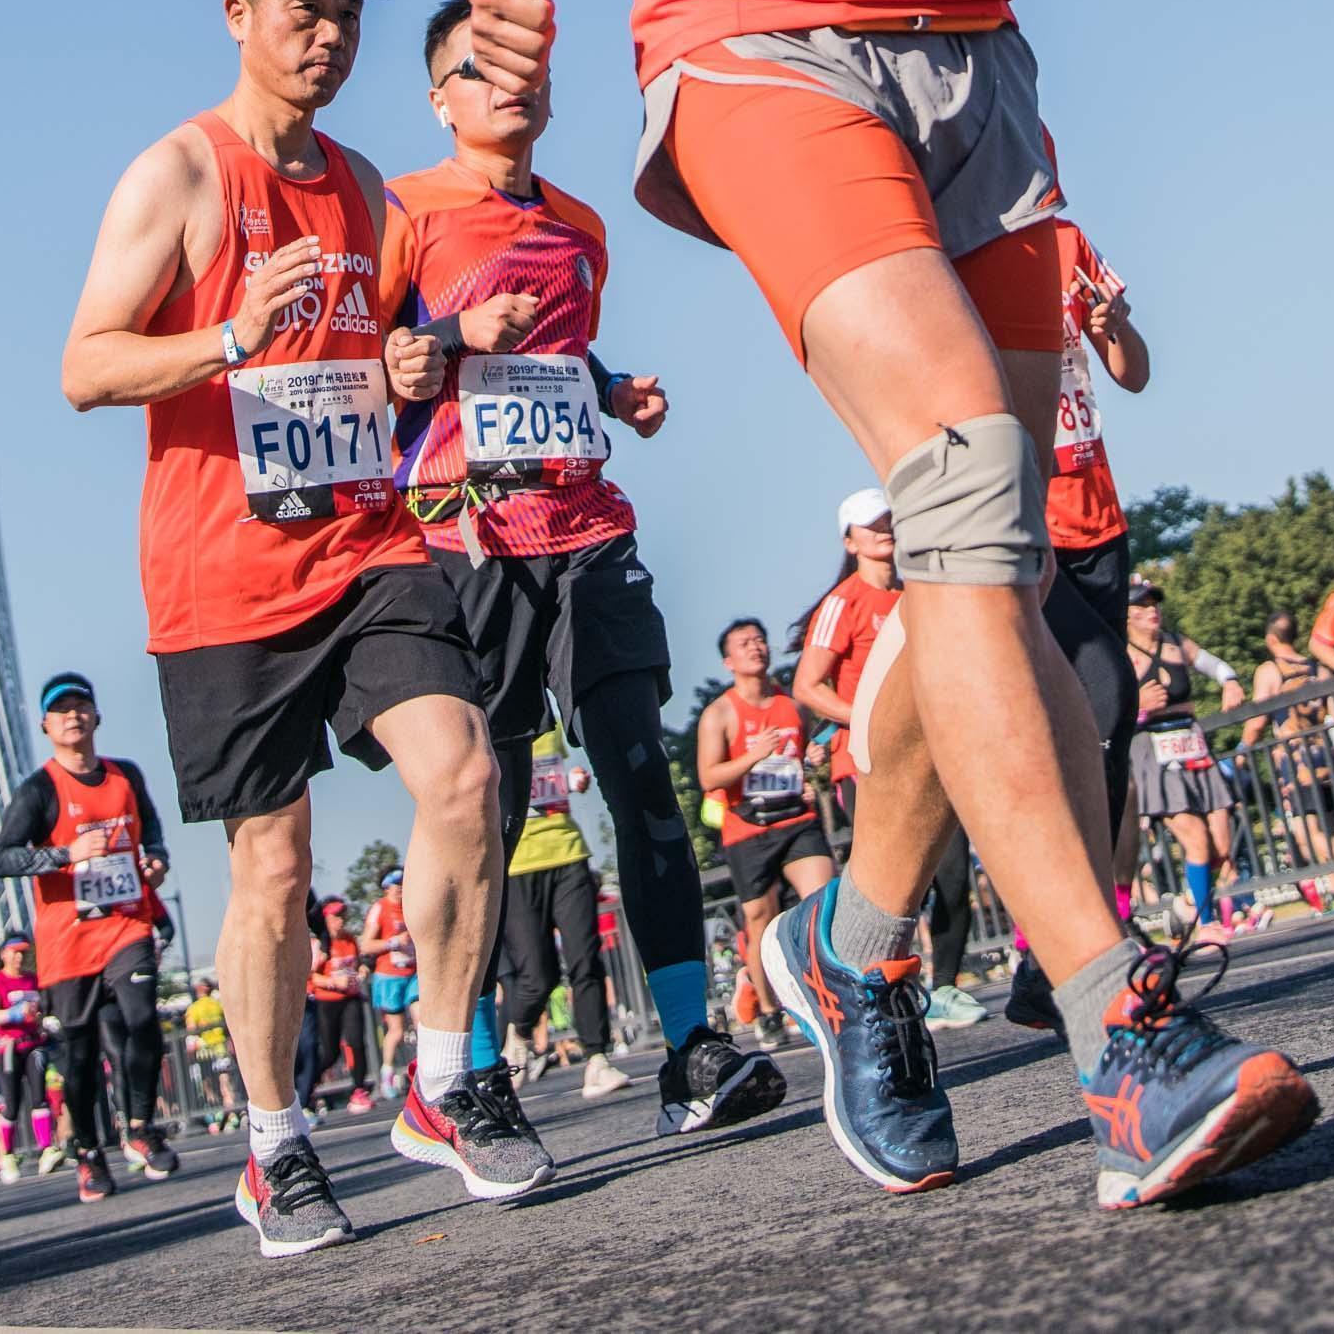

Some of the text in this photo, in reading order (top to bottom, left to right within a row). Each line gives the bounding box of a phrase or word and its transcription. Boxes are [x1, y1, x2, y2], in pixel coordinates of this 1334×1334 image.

[330, 314, 378, 335] adidas
[287, 371, 368, 388] 2019广州马拉松赛
[289, 387, 303, 396] 2019
[304, 385, 342, 395] GUANGZHOU
[552, 385, 564, 394] 38
[342, 394, 354, 405] 36
[475, 400, 596, 447] F2054
[252, 411, 383, 476] F0171
[276, 506, 312, 519] adidas
[80, 872, 137, 901] F1323
